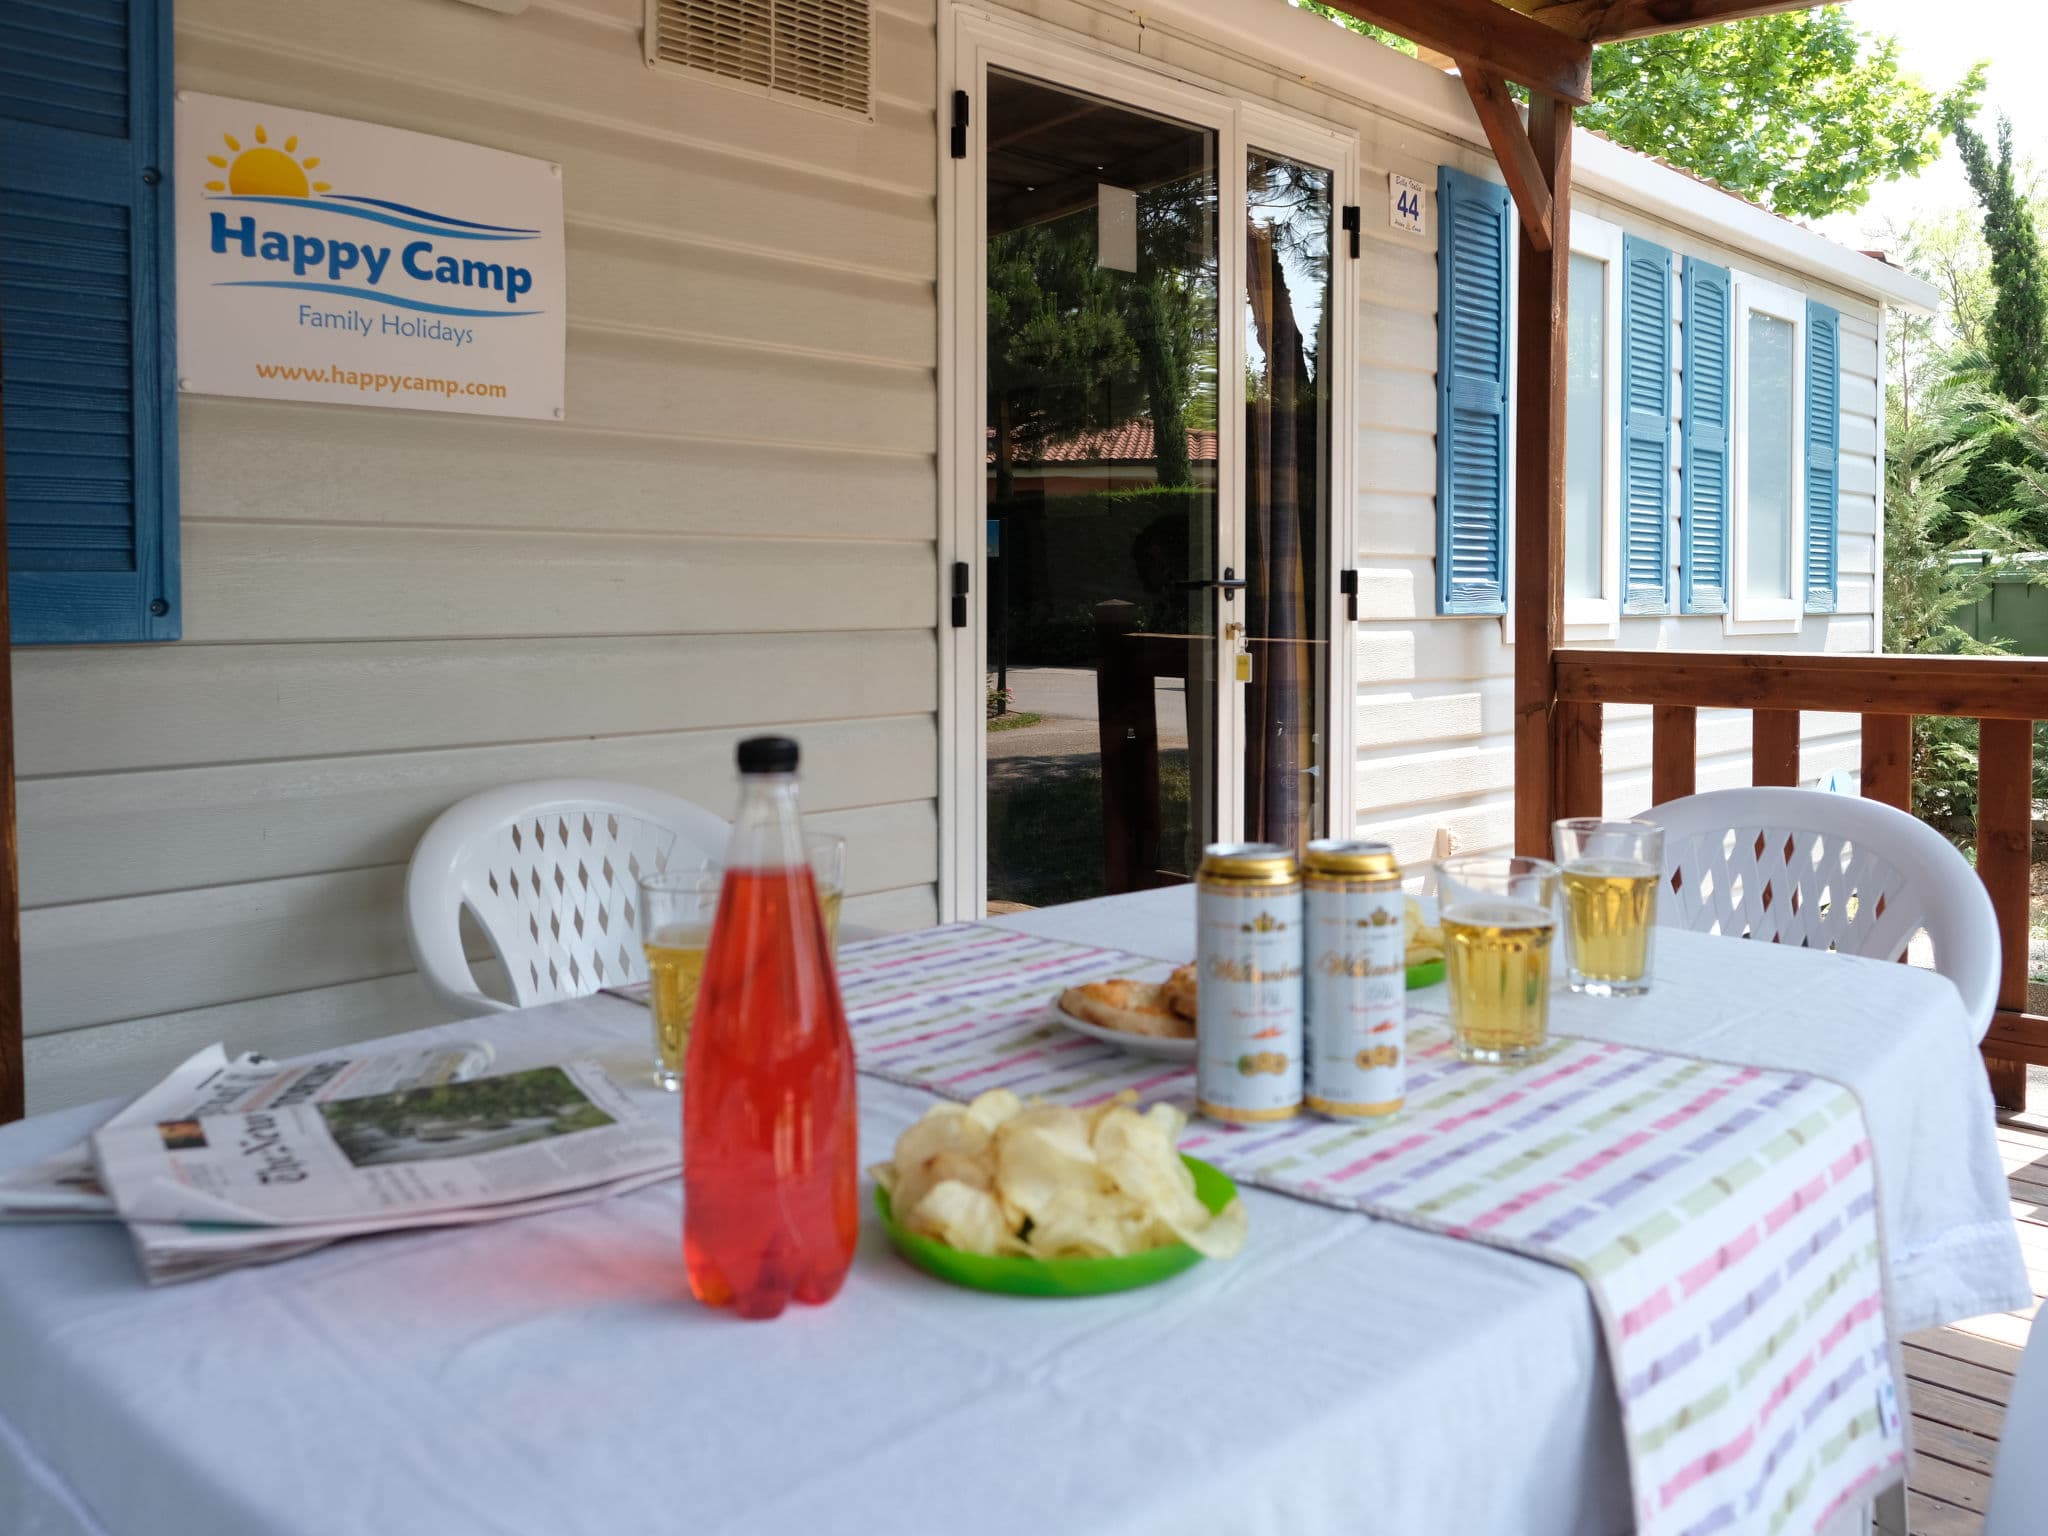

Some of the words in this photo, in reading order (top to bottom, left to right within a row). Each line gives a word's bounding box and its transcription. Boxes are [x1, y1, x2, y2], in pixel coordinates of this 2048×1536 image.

[1397, 190, 1419, 221] 44
[209, 211, 391, 285] Happy
[401, 241, 533, 303] Camp
[298, 304, 373, 338] Family
[381, 313, 474, 347] Holidays
[255, 363, 508, 399] www.happycamp.com
